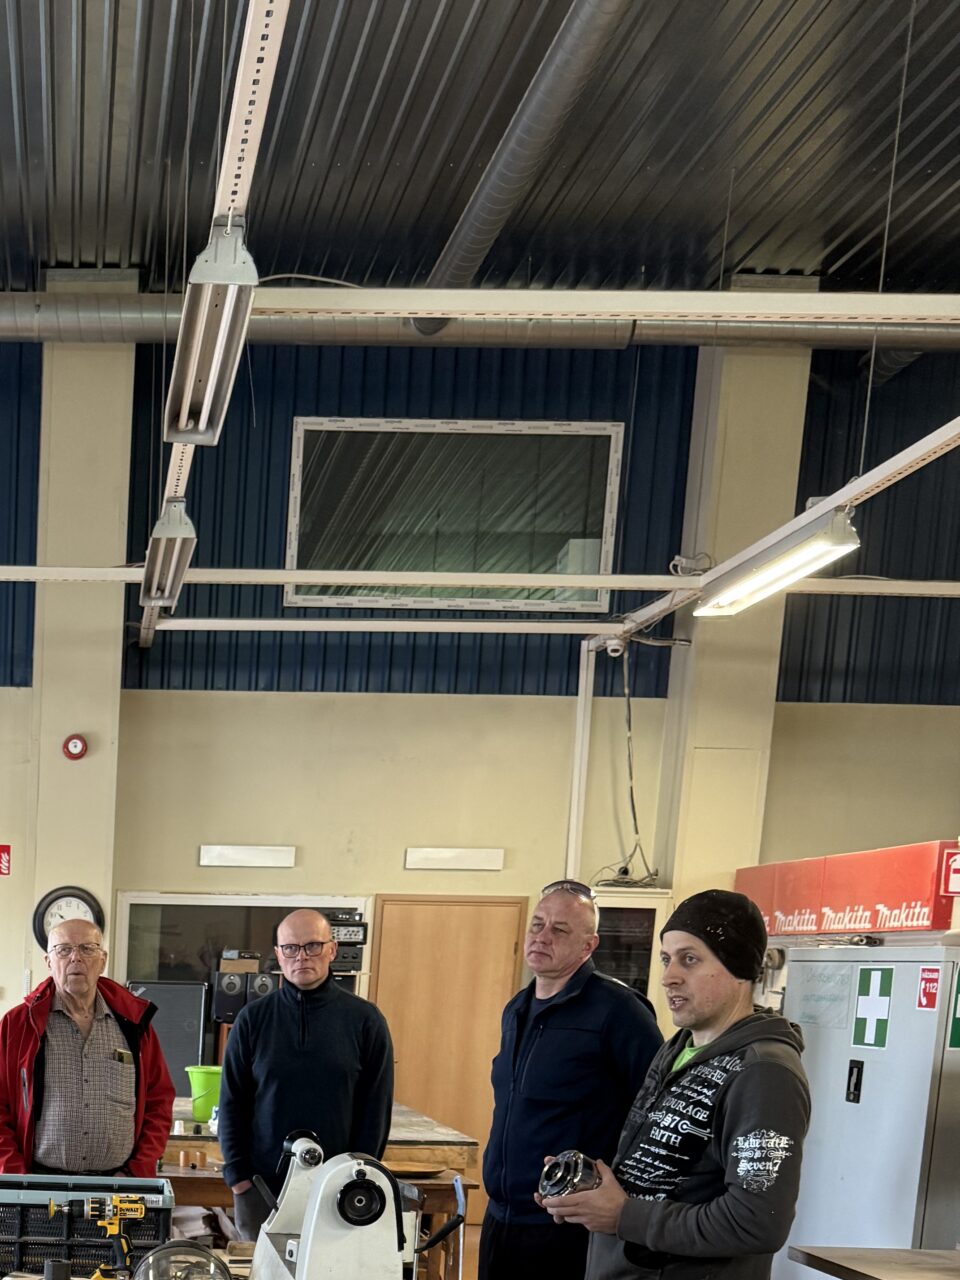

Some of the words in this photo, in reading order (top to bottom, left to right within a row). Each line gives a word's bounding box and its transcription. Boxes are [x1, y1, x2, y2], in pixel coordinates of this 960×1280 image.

[774, 908, 817, 932] Makita
[822, 905, 872, 930] Makita
[876, 901, 930, 928] Makita
[925, 982, 938, 993] 112
[662, 1097, 709, 1121] COURAGE
[649, 1126, 682, 1147] FAITH
